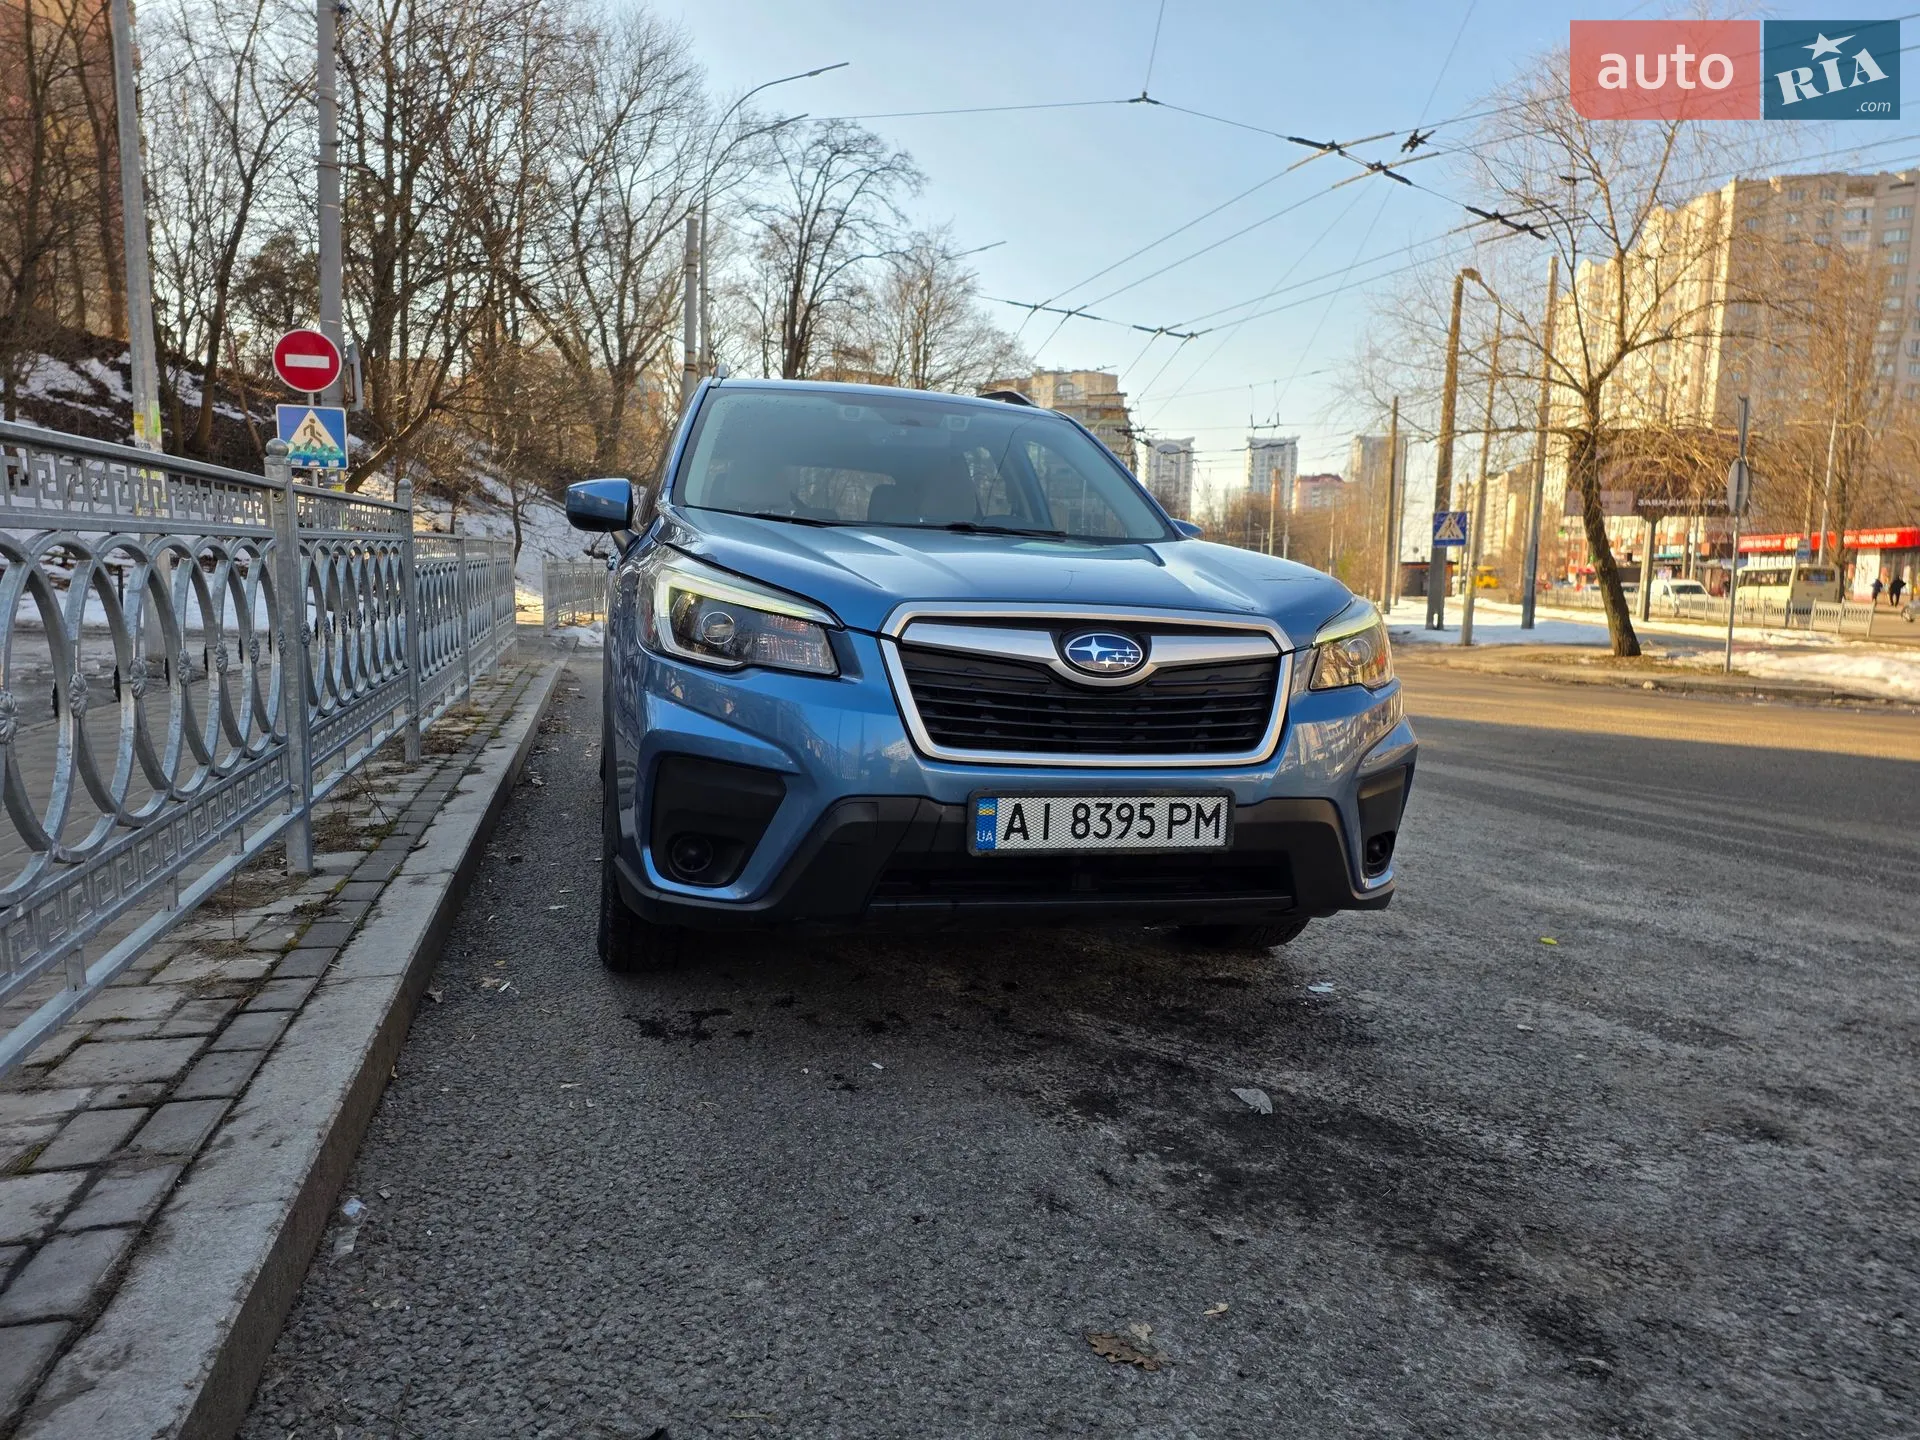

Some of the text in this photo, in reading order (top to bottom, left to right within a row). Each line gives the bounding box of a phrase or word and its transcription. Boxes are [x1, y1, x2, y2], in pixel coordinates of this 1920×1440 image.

[1003, 802, 1222, 840] AI 8395 PM
[976, 830, 994, 842] UA
